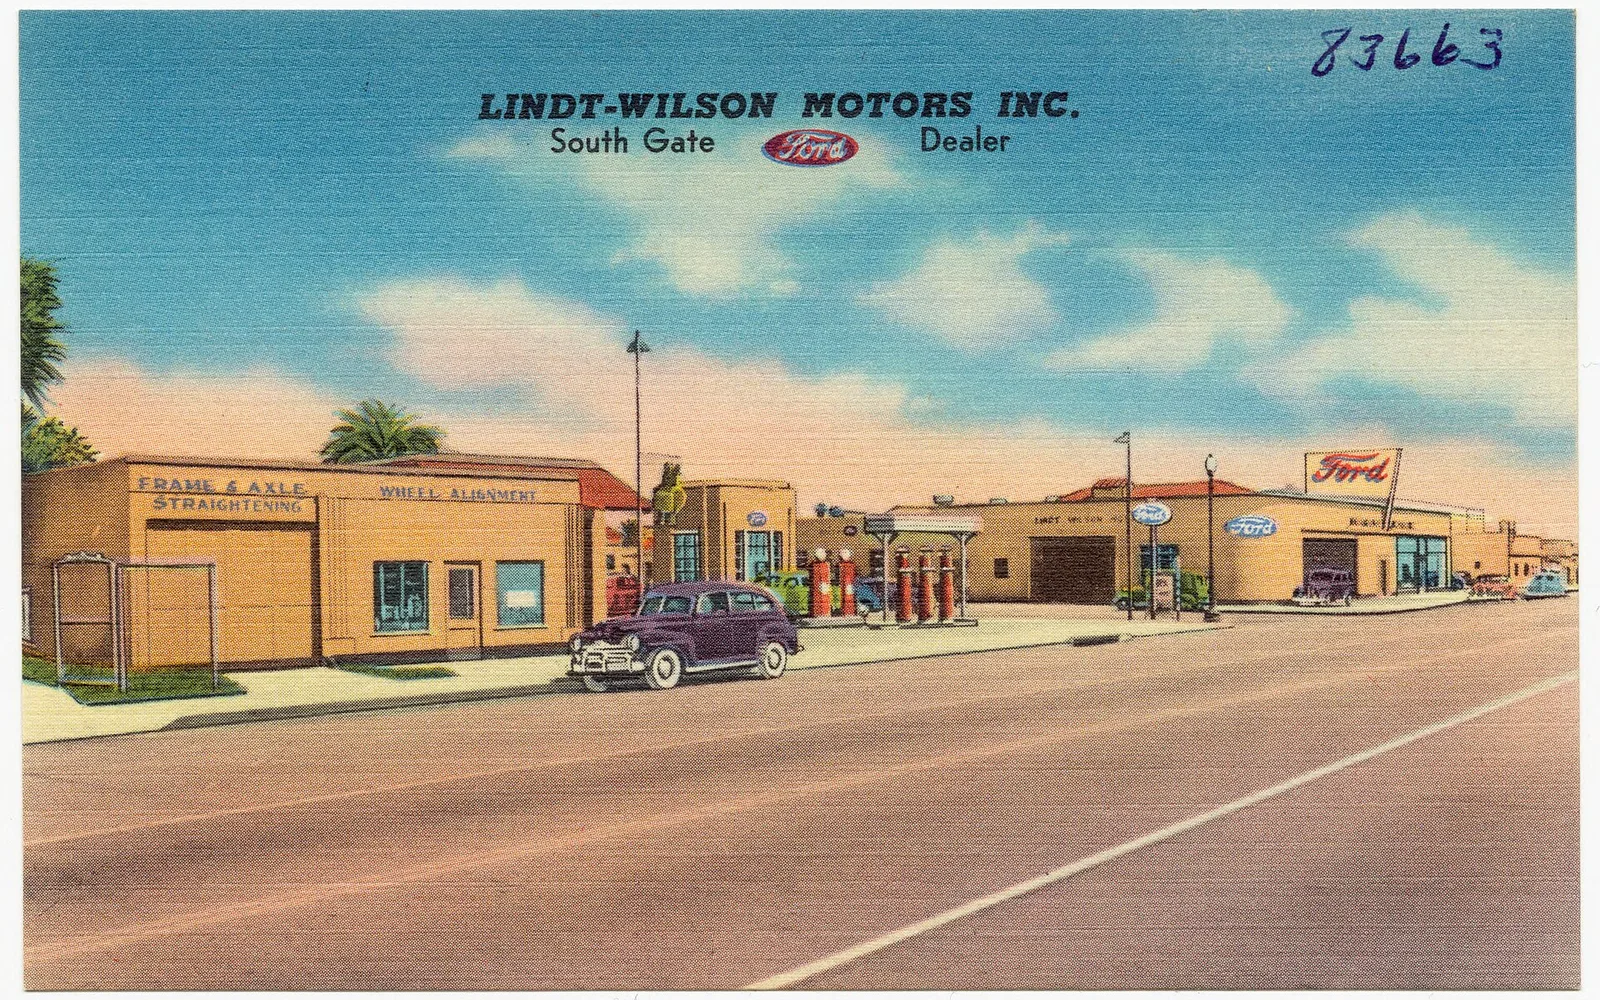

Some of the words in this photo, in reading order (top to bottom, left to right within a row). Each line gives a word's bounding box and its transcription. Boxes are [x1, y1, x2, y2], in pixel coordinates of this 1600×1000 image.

[1311, 23, 1502, 77] 83663
[1311, 453, 1390, 483] Ford
[138, 477, 215, 493] FRAME
[249, 481, 306, 499] AXLE
[379, 485, 440, 498] WHEEL
[450, 488, 536, 501] ALIGNMENT
[153, 495, 302, 513] STRAIGHTENING
[1230, 518, 1273, 535] Ford
